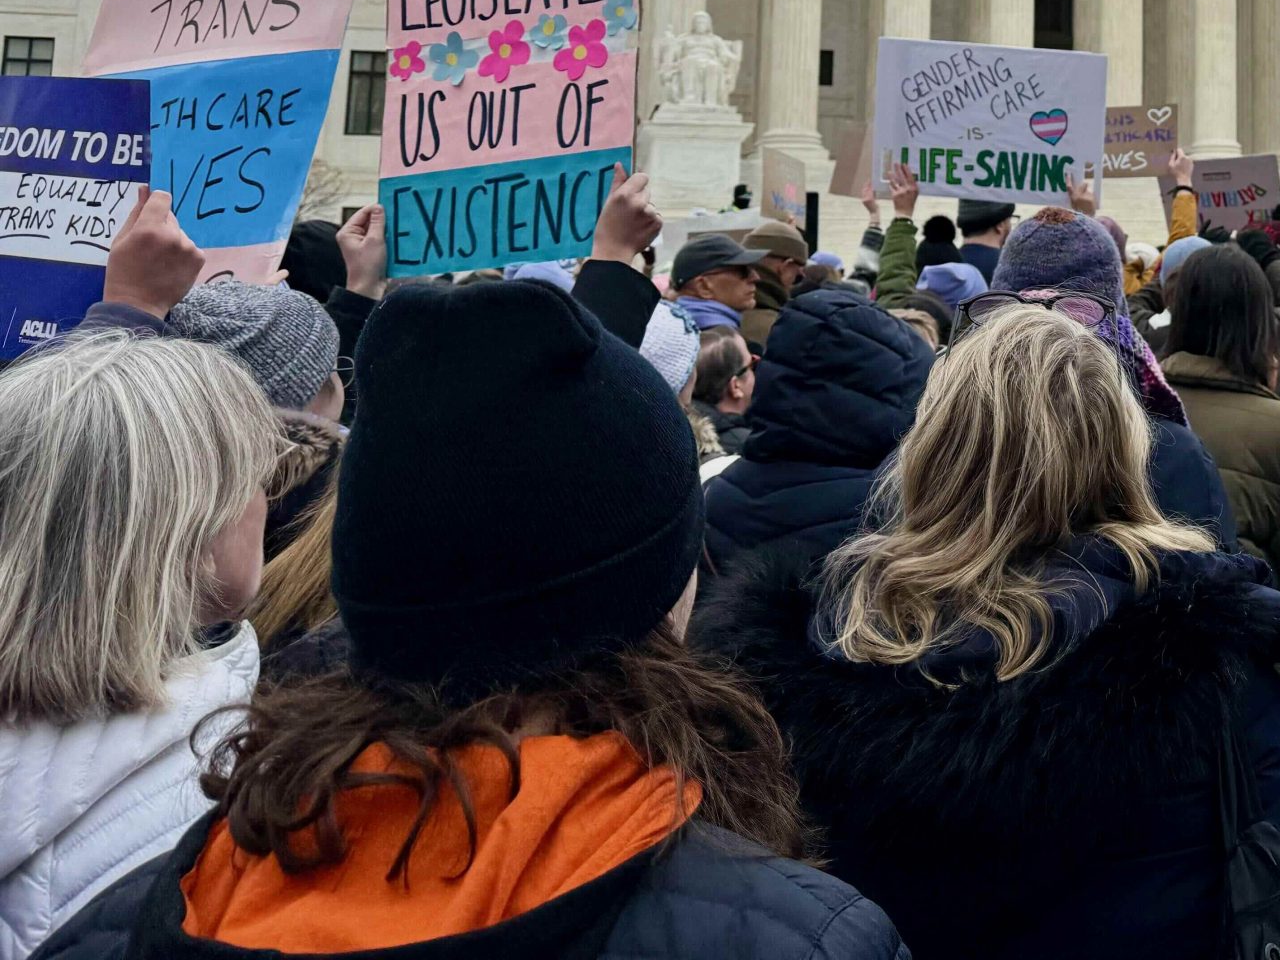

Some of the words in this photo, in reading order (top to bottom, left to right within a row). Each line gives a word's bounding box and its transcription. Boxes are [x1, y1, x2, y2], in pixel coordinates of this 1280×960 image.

[901, 48, 981, 102] GENDER
[905, 57, 1013, 138] AFFIRMING
[990, 73, 1045, 120] CARE
[400, 90, 446, 167] US
[467, 83, 536, 151] OUT
[556, 79, 609, 148] OF
[71, 131, 108, 164] TO
[112, 133, 144, 167] BE
[901, 147, 1074, 193] LIFE-SAVING
[17, 173, 132, 215] EQUALITY
[170, 146, 271, 220] VES
[0, 206, 56, 230] TRANS
[65, 214, 116, 239] KIDS
[20, 319, 57, 339] ACLU
